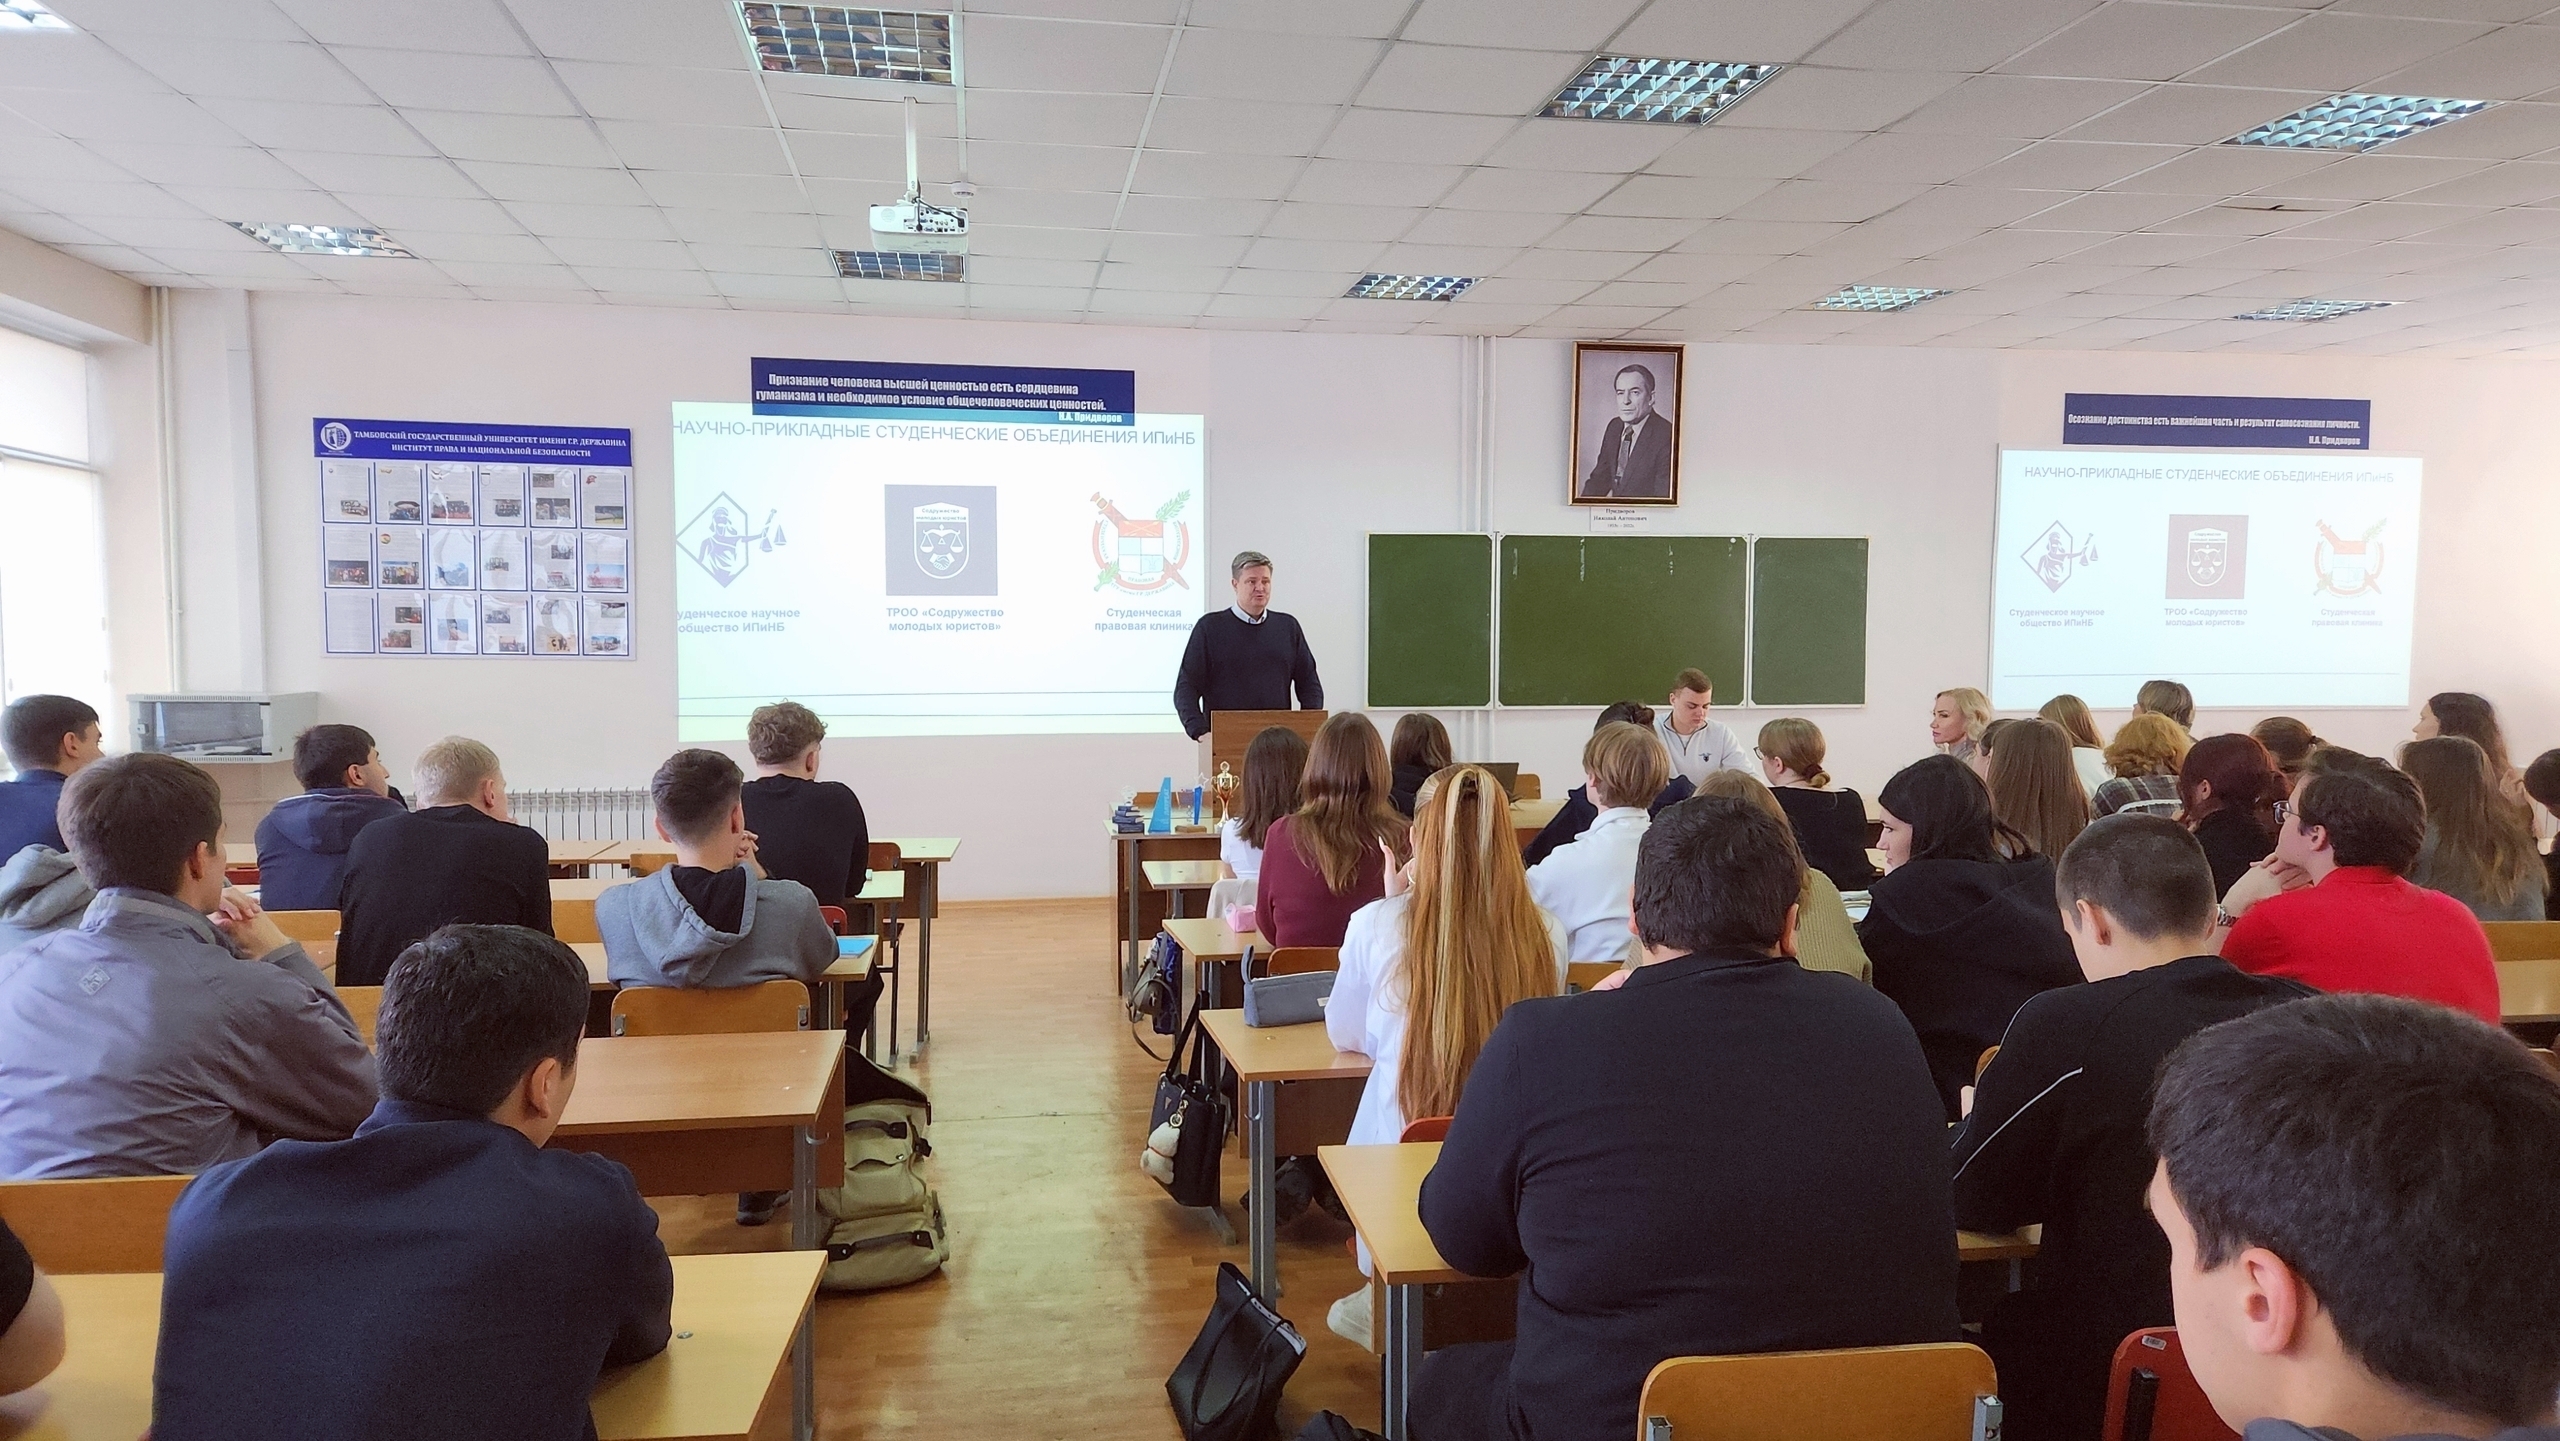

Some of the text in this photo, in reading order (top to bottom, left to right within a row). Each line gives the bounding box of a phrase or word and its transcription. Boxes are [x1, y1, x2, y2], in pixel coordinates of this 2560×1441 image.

[768, 374, 1079, 395] Признание человека высшей ценностью есть сердцевина
[756, 390, 1107, 411] гуманизма и необходимое условие общечеловеческих ценностей.
[1074, 413, 1122, 423] Придворов
[2068, 414, 2107, 424] Осознание
[2107, 416, 2153, 426] достоинства
[2153, 417, 2170, 425] есть
[2170, 415, 2212, 426] важнейшая
[2212, 418, 2233, 427] часть
[2234, 418, 2239, 427] и
[2240, 419, 2275, 428] результат
[2276, 420, 2325, 429] самосознания
[353, 430, 407, 439] ТАМБОВСКИЙ
[407, 432, 483, 442] ГОСУДАРСТВЕННЫЙ
[484, 435, 538, 444] УНИВЕРСИТЕТ
[539, 437, 567, 445] ИМЕНИ
[580, 438, 626, 447] ДЕРЖАВИНА
[673, 421, 1196, 445] НАУЧНО-ПРИКЛАДНЫЕ СТУДЕНЧЕСКИЕ ОБЪЕДИНЕНИЯ ИПиНБ
[434, 445, 459, 453] ПРАВА
[467, 446, 532, 455] НАЦИОНАЛЬНОЙ
[532, 448, 591, 457] БЕЗОПАСНОСТИ
[2025, 467, 2394, 483] НАУЧНО-ПРИКЛАДНЫЕ СТУДЕНЧЕСКИЕ ОБЪЕДИНЕНИЯ ИПиНБ
[677, 609, 801, 620] уденческое научное
[886, 607, 1004, 619] ТРОО «Содружество
[1106, 608, 1182, 619] Студенческая
[2009, 608, 2105, 618] Студенческое научное
[2164, 608, 2187, 616] ТРОО
[2320, 608, 2376, 617] Студенческая
[678, 622, 785, 634] общество ИПиНБ
[889, 623, 1001, 632] молодых юристов»
[1094, 623, 1147, 632] правовая
[2020, 619, 2094, 627] общество ИПиНБ
